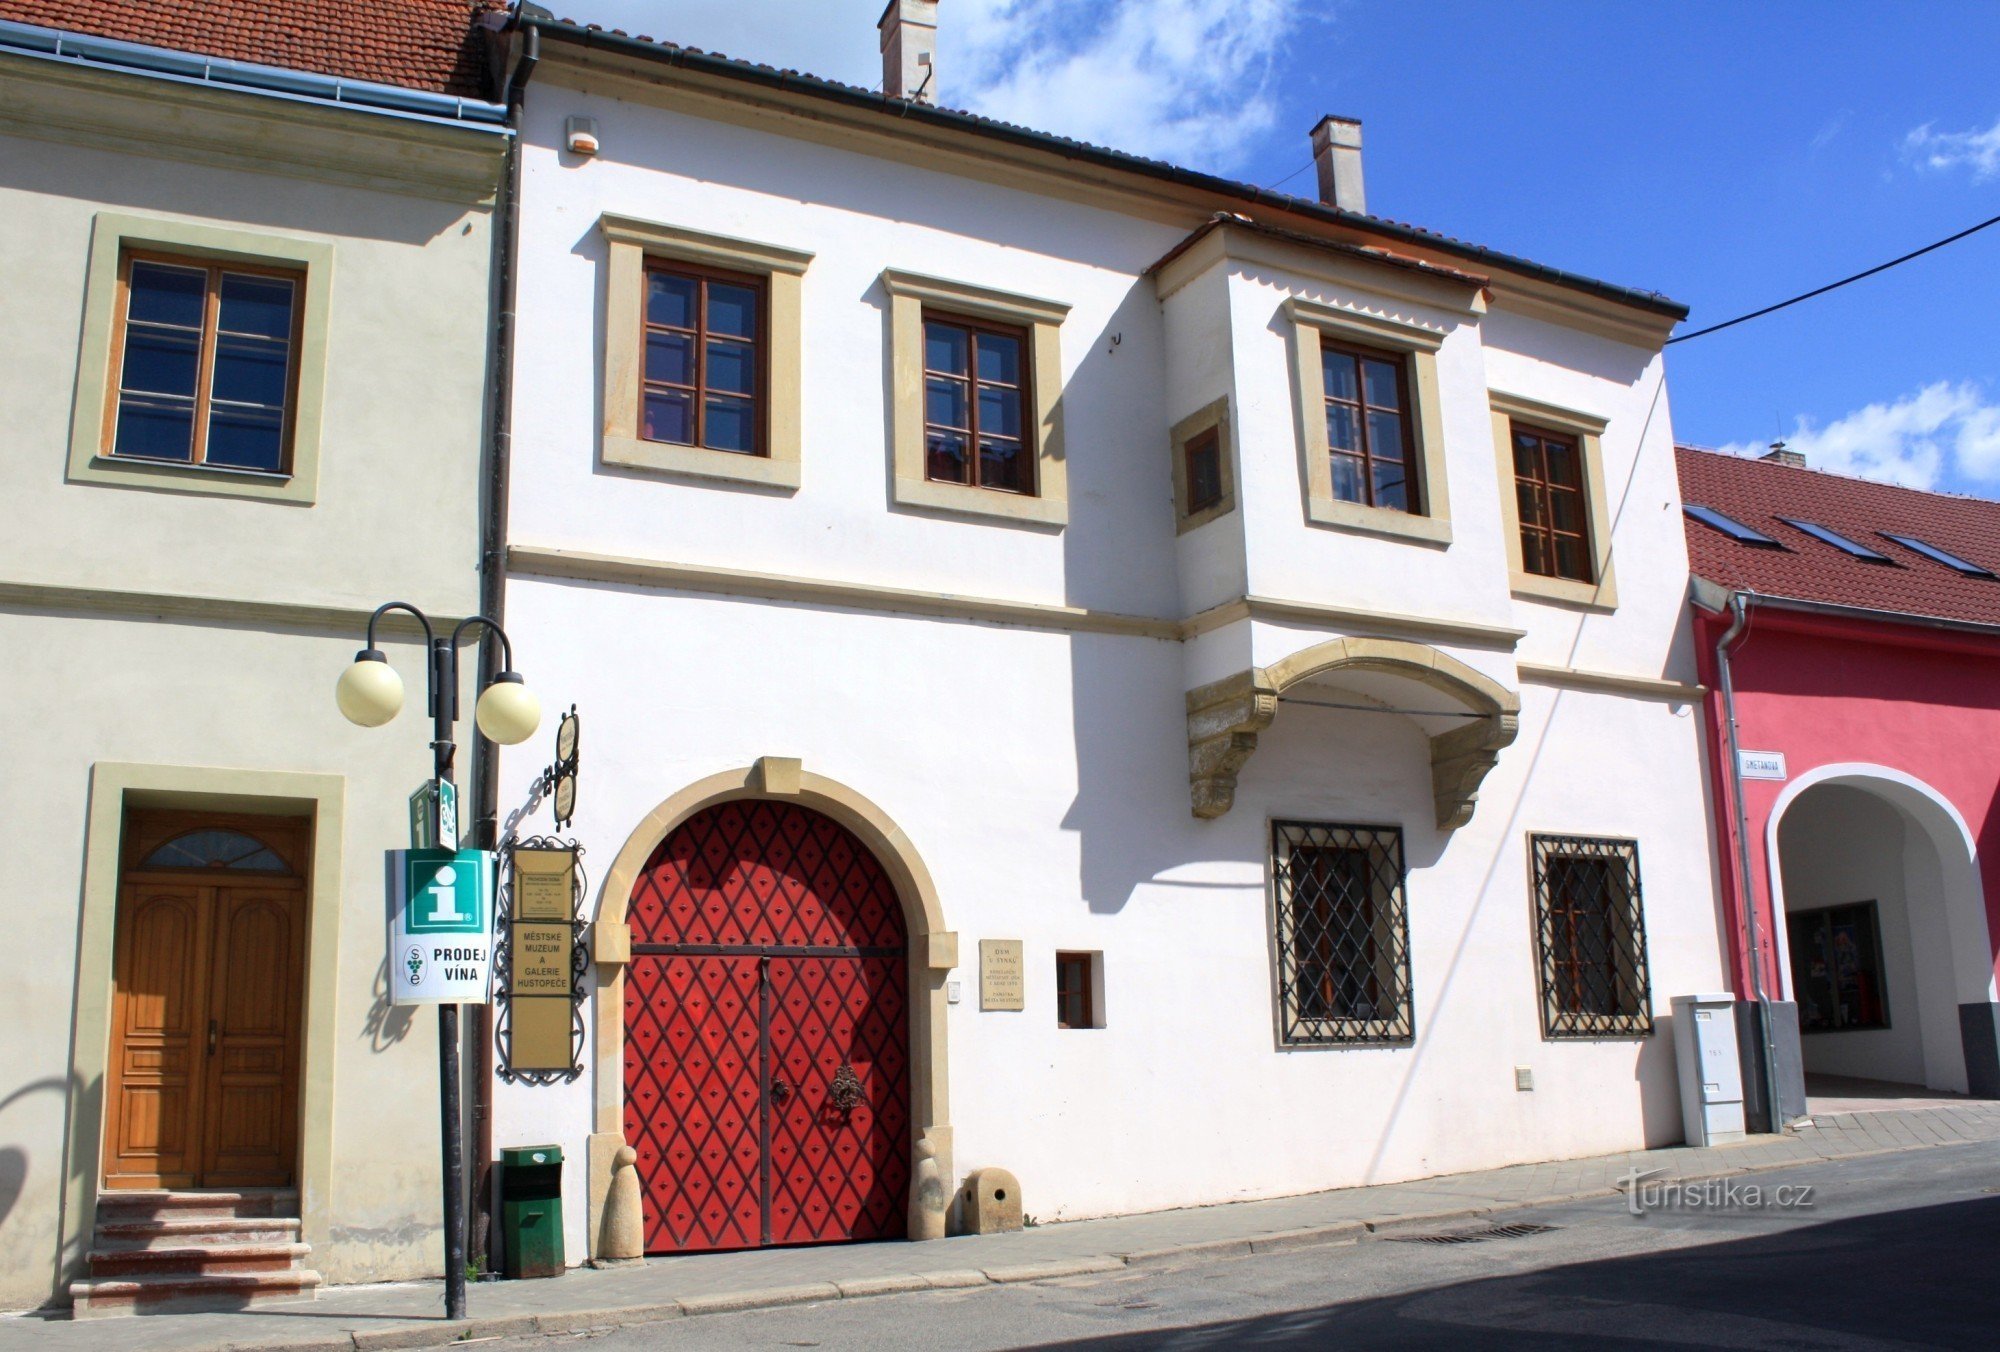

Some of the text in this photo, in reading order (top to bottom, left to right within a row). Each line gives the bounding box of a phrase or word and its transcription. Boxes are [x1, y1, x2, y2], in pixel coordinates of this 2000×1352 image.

[523, 931, 562, 941] MĚSTSKÉ
[525, 944, 560, 953] MUZEUM
[434, 948, 486, 962] PRODEJ
[540, 956, 545, 964] A
[444, 964, 478, 981] VÍNA
[525, 967, 560, 976] GALERIE
[517, 978, 567, 988] HUSTOPEČE
